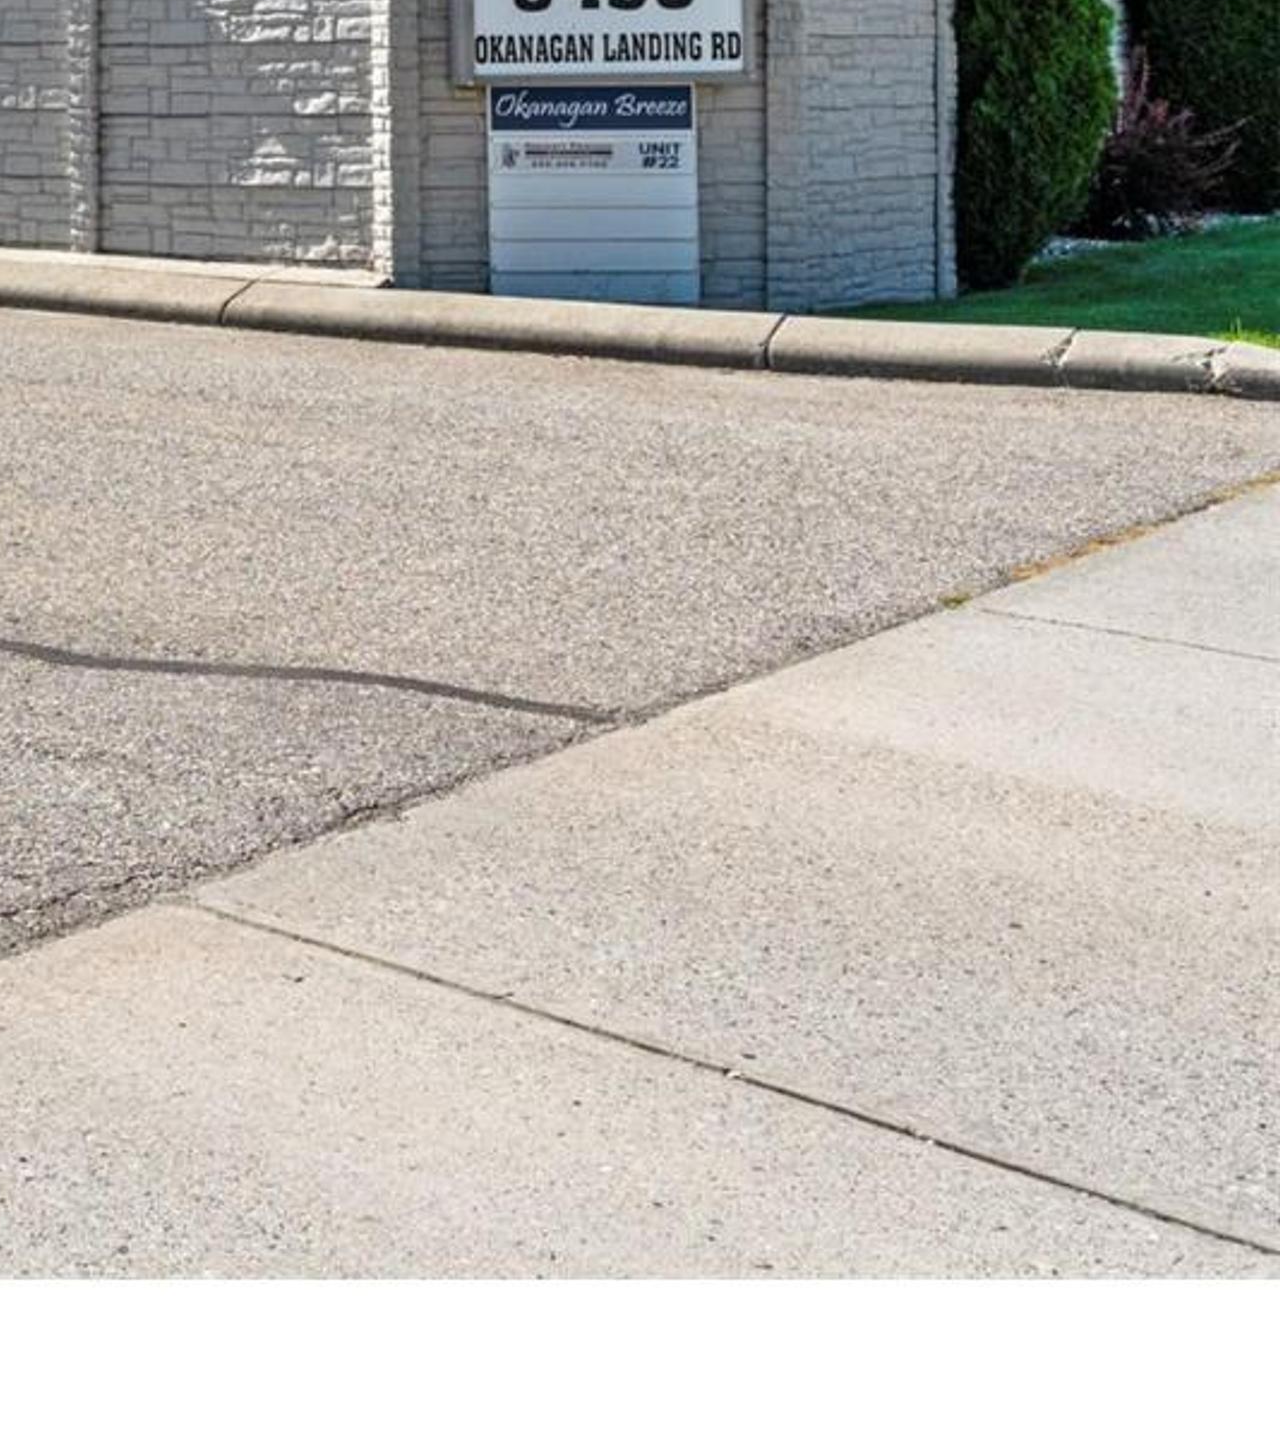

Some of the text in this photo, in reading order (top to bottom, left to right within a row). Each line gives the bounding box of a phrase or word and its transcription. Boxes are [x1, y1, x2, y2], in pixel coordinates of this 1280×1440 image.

[475, 31, 741, 64] OKANAGAN LANDING RD
[495, 91, 687, 128] Okanagan Breeze
[639, 142, 681, 155] UNIT
